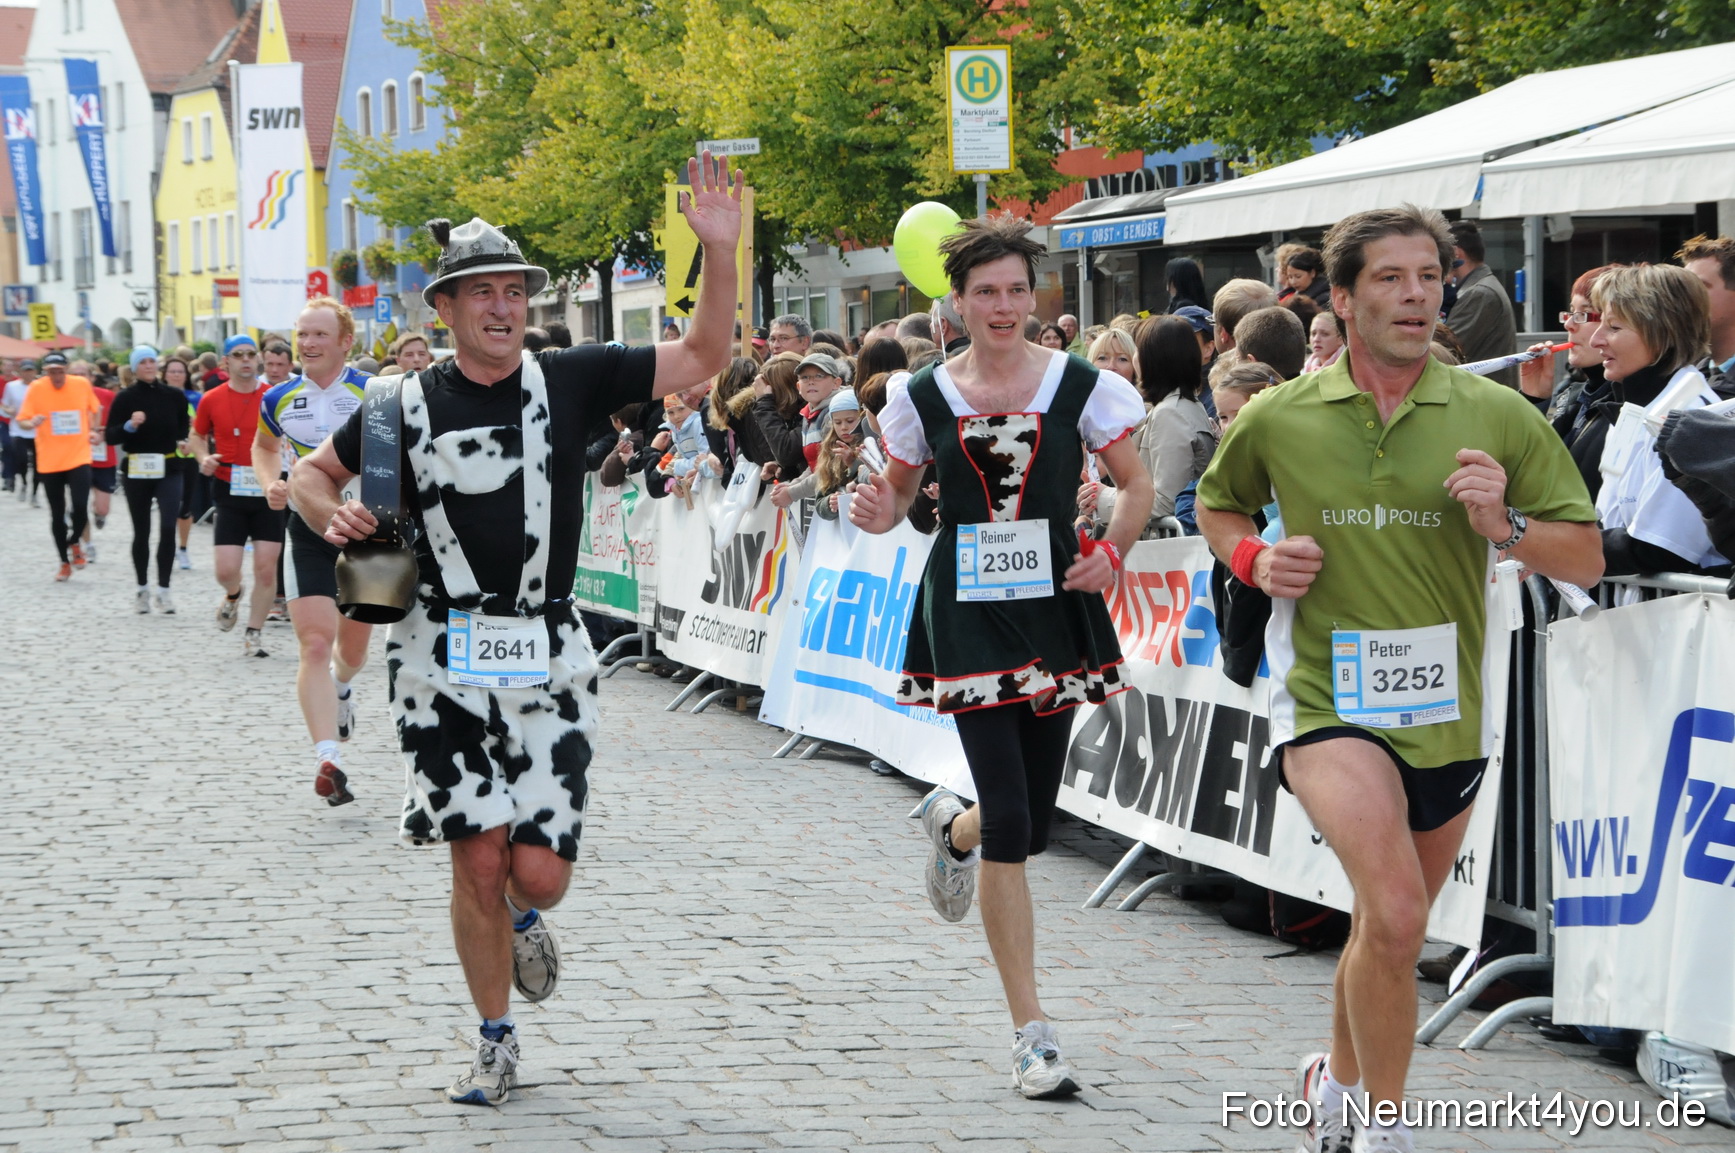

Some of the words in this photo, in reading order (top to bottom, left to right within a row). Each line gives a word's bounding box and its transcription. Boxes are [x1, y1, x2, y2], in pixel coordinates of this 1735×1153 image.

[960, 109, 999, 117] Marktplatz
[732, 142, 756, 151] Gasse
[1083, 164, 1174, 201] ANTON
[1092, 227, 1114, 242] OBST
[1123, 220, 1159, 239] GEMÜSE
[378, 300, 389, 321] P
[36, 314, 49, 332] B
[1322, 508, 1372, 525] EURO
[1389, 509, 1442, 527] POLES
[981, 530, 1017, 544] Reiner
[961, 553, 968, 564] C
[983, 550, 1039, 573] 2308
[455, 638, 461, 649] B
[478, 639, 535, 660] 2641
[1369, 640, 1412, 658] Peter
[1342, 668, 1350, 681] B
[1372, 663, 1445, 693] 3252
[1413, 705, 1456, 720] PFLEIDERER
[1062, 686, 1280, 857] ACKNER
